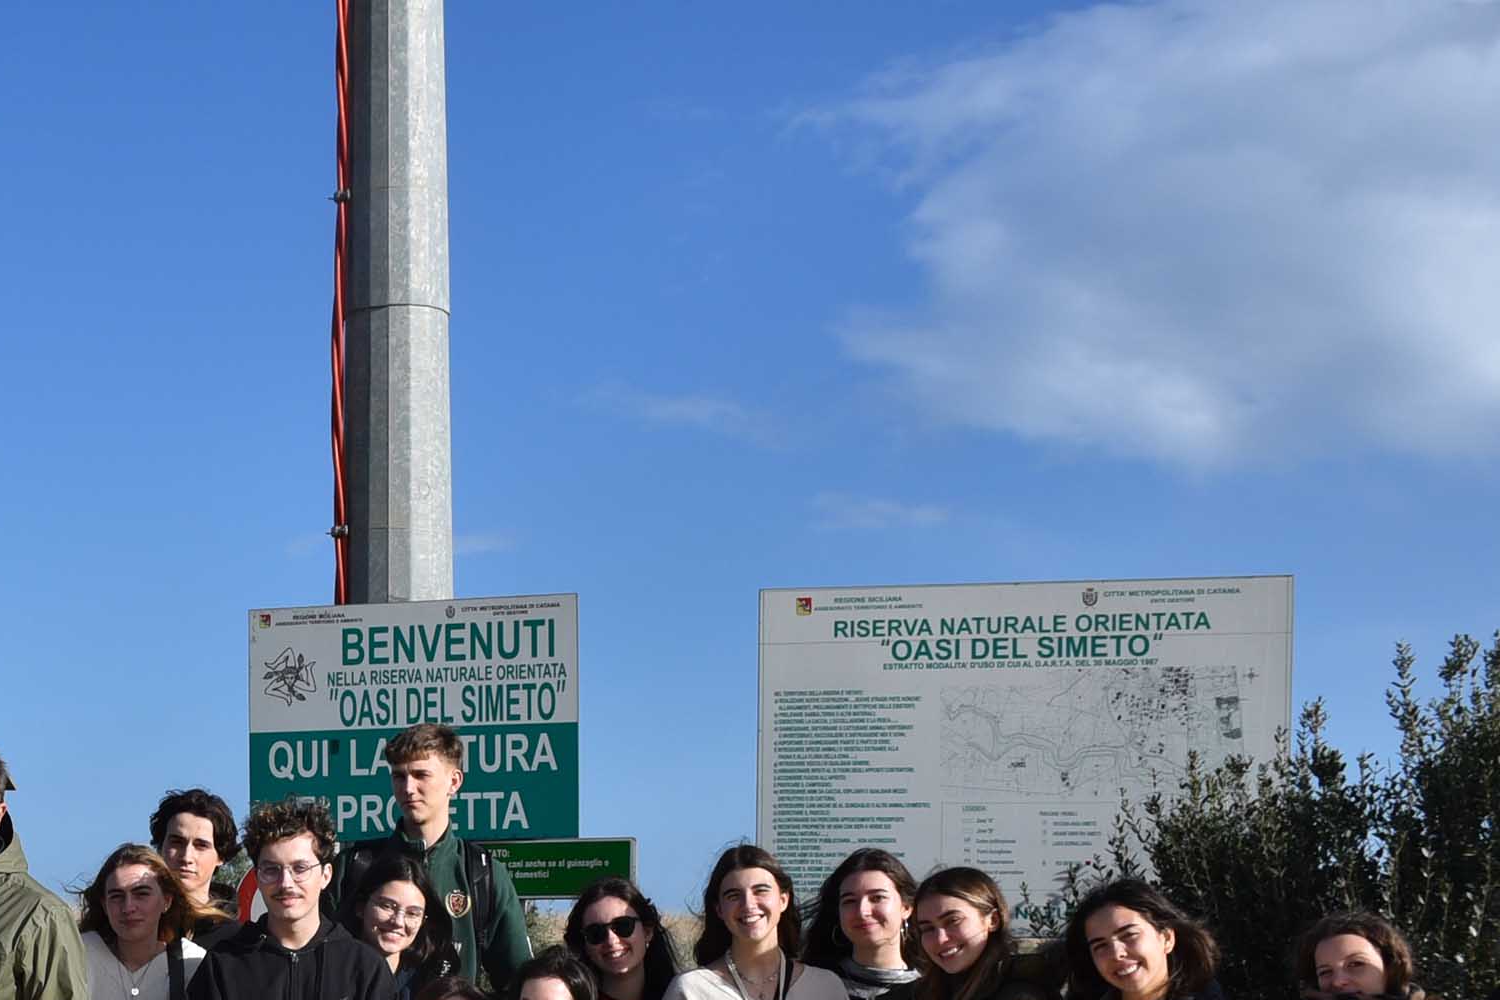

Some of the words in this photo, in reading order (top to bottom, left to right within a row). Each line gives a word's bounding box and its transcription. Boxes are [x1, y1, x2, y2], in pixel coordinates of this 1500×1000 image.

[834, 596, 866, 604] REGIONE
[833, 618, 933, 638] RISERVA
[940, 615, 1067, 637] NATURALE
[1075, 611, 1211, 633] ORIENTATA
[342, 618, 555, 666] BENVENUTI
[971, 637, 1028, 660] DEL
[327, 671, 367, 687] NELLA
[370, 668, 423, 686] RISERVA
[426, 665, 493, 684] NATURALE
[496, 662, 568, 681] ORIENTATA
[883, 662, 924, 670] ESTRATTO
[996, 660, 1005, 668] DI
[1007, 660, 1021, 668] CUI
[1075, 659, 1091, 667] DEL
[1104, 658, 1138, 666] MAGGIO
[329, 687, 397, 727] "OASI
[406, 686, 454, 724] DEL
[461, 679, 566, 724] SIMETO"
[268, 739, 329, 781] QUI
[350, 737, 392, 777] LA
[457, 733, 558, 774] TURA
[337, 791, 529, 833] PROTTA
[488, 849, 510, 858] ATO:
[507, 860, 524, 868] cani
[525, 859, 546, 867] anche
[567, 858, 602, 869] guinzaglio
[514, 871, 549, 879] domestici
